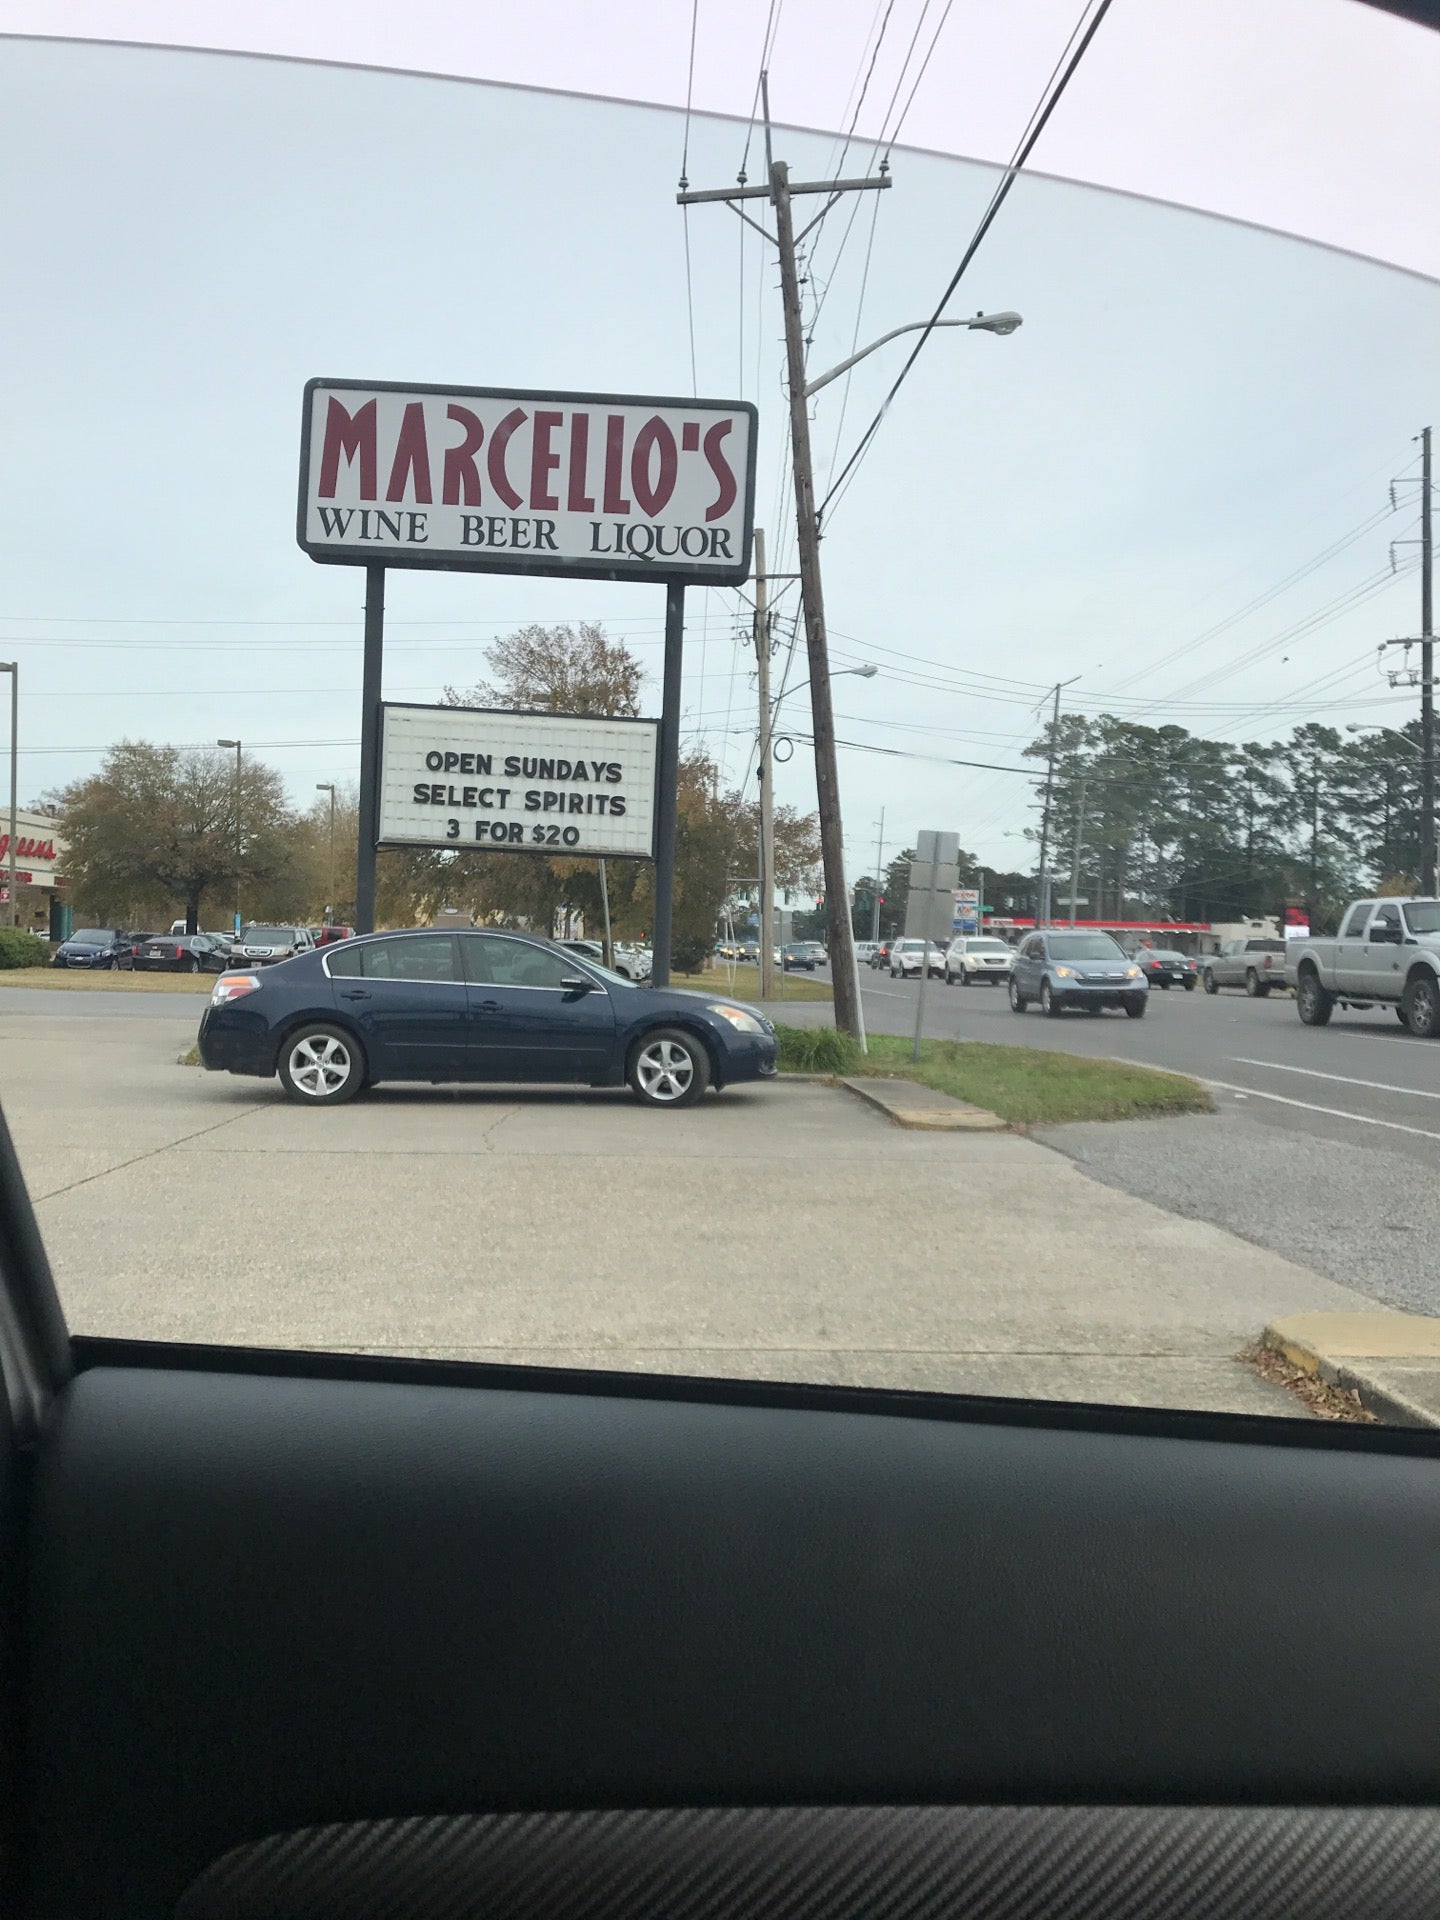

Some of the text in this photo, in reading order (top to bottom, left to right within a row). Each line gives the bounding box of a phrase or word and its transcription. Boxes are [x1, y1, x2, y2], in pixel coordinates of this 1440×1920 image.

[318, 395, 737, 522] MARCELLO'S
[317, 506, 734, 562] WINE BEER LIQUOR
[425, 750, 623, 783] OPEN SUNDAYS
[413, 783, 626, 816] SELECT SPIRITS
[446, 818, 580, 846] 3 FOR $20
